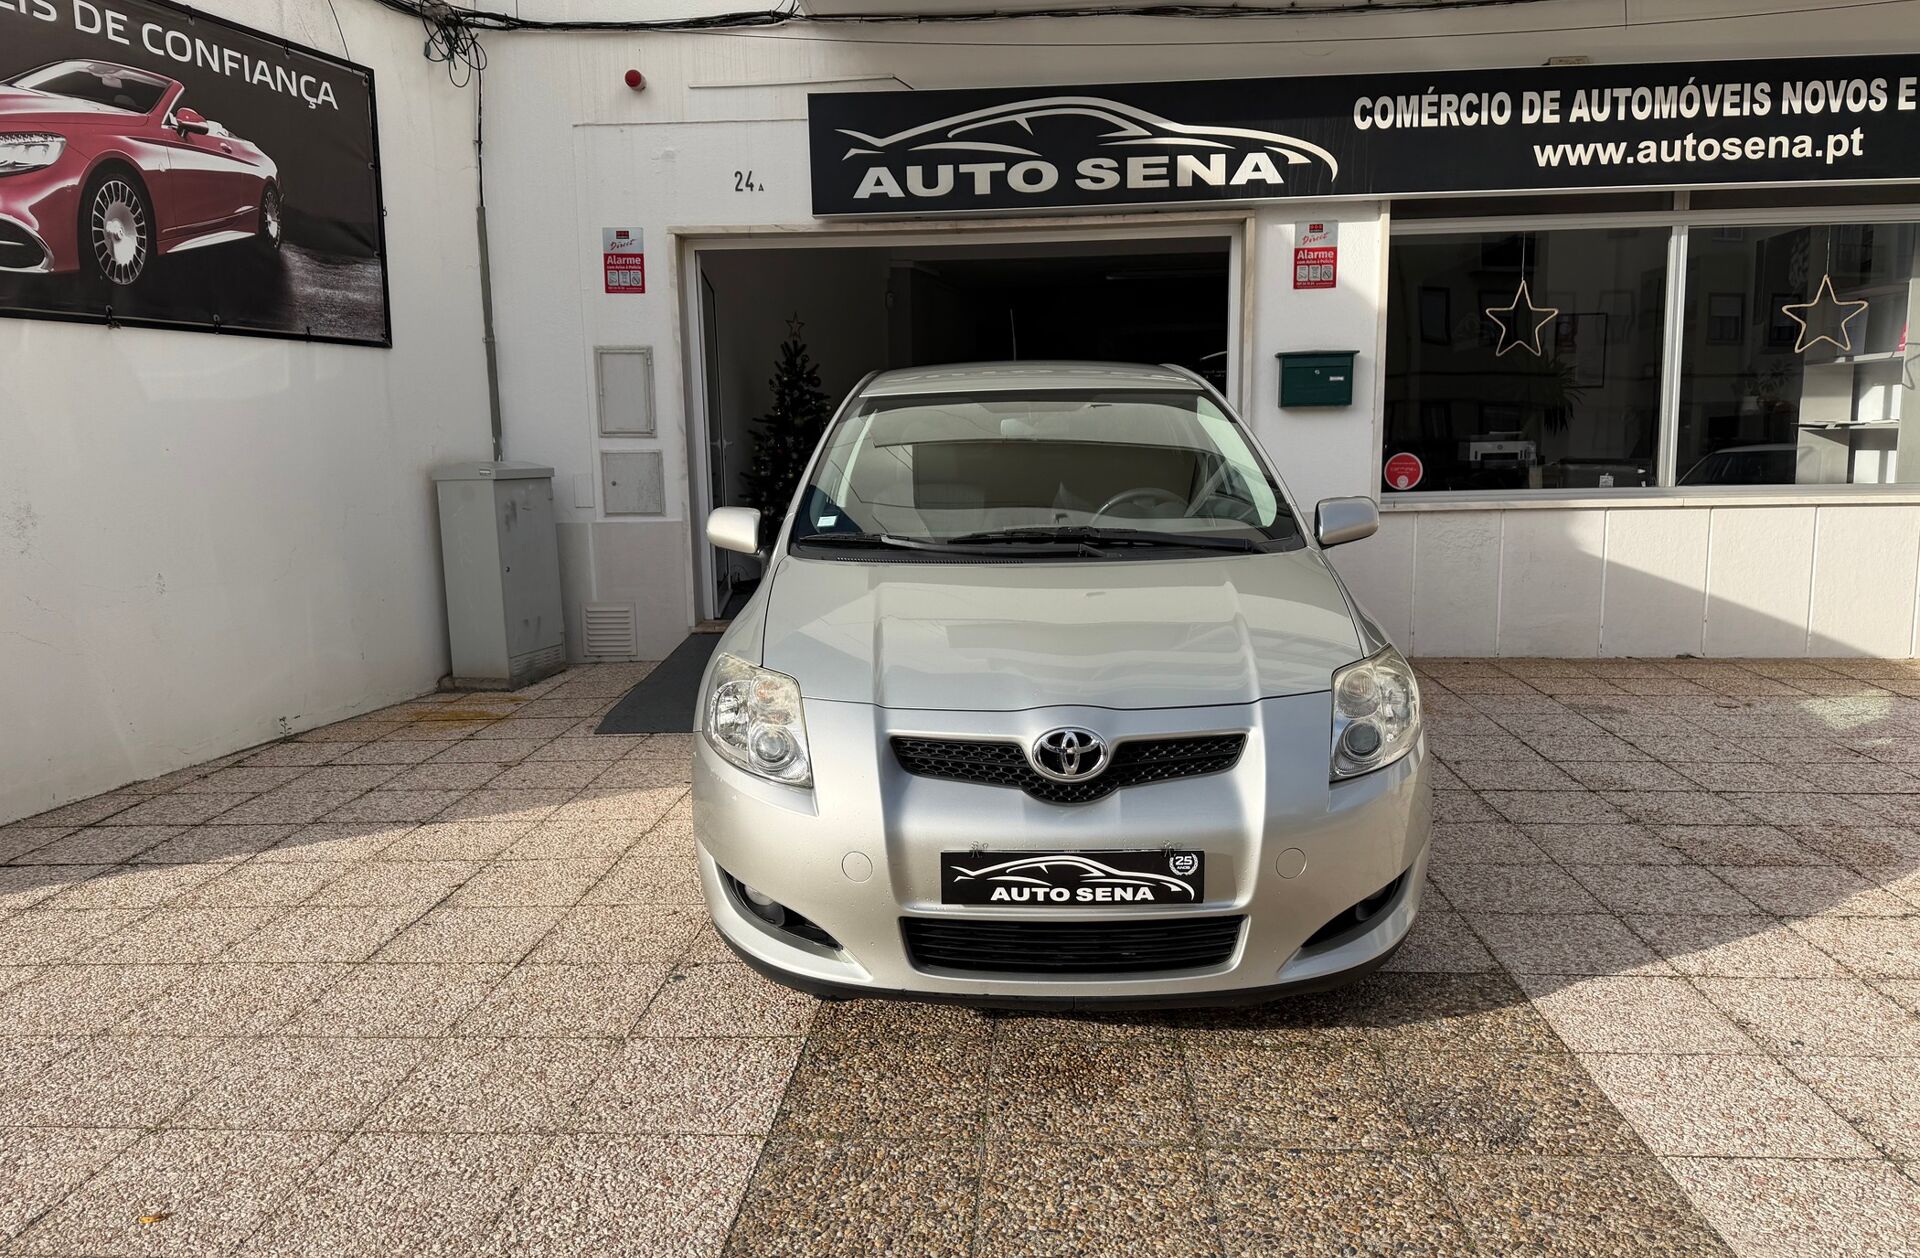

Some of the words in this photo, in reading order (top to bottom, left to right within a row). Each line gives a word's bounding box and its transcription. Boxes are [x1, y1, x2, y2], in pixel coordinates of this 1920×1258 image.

[72, 0, 130, 45] DE
[142, 23, 339, 110] CONFIANÇA
[1354, 87, 1511, 130] COMÉRCIO
[1522, 91, 1560, 124] DE
[1569, 77, 1771, 122] AUTOMÓVEIS
[1781, 78, 1888, 114] NOVOS
[1898, 77, 1917, 110] E
[1534, 127, 1864, 167] www.autosena.pt
[854, 161, 1058, 198] AUTO
[1075, 153, 1285, 189] SENA
[607, 255, 641, 265] Alarme
[1297, 249, 1334, 260] Alarme
[1175, 855, 1193, 865] 25
[990, 887, 1071, 901] AUTO
[1076, 887, 1155, 902] SENA
